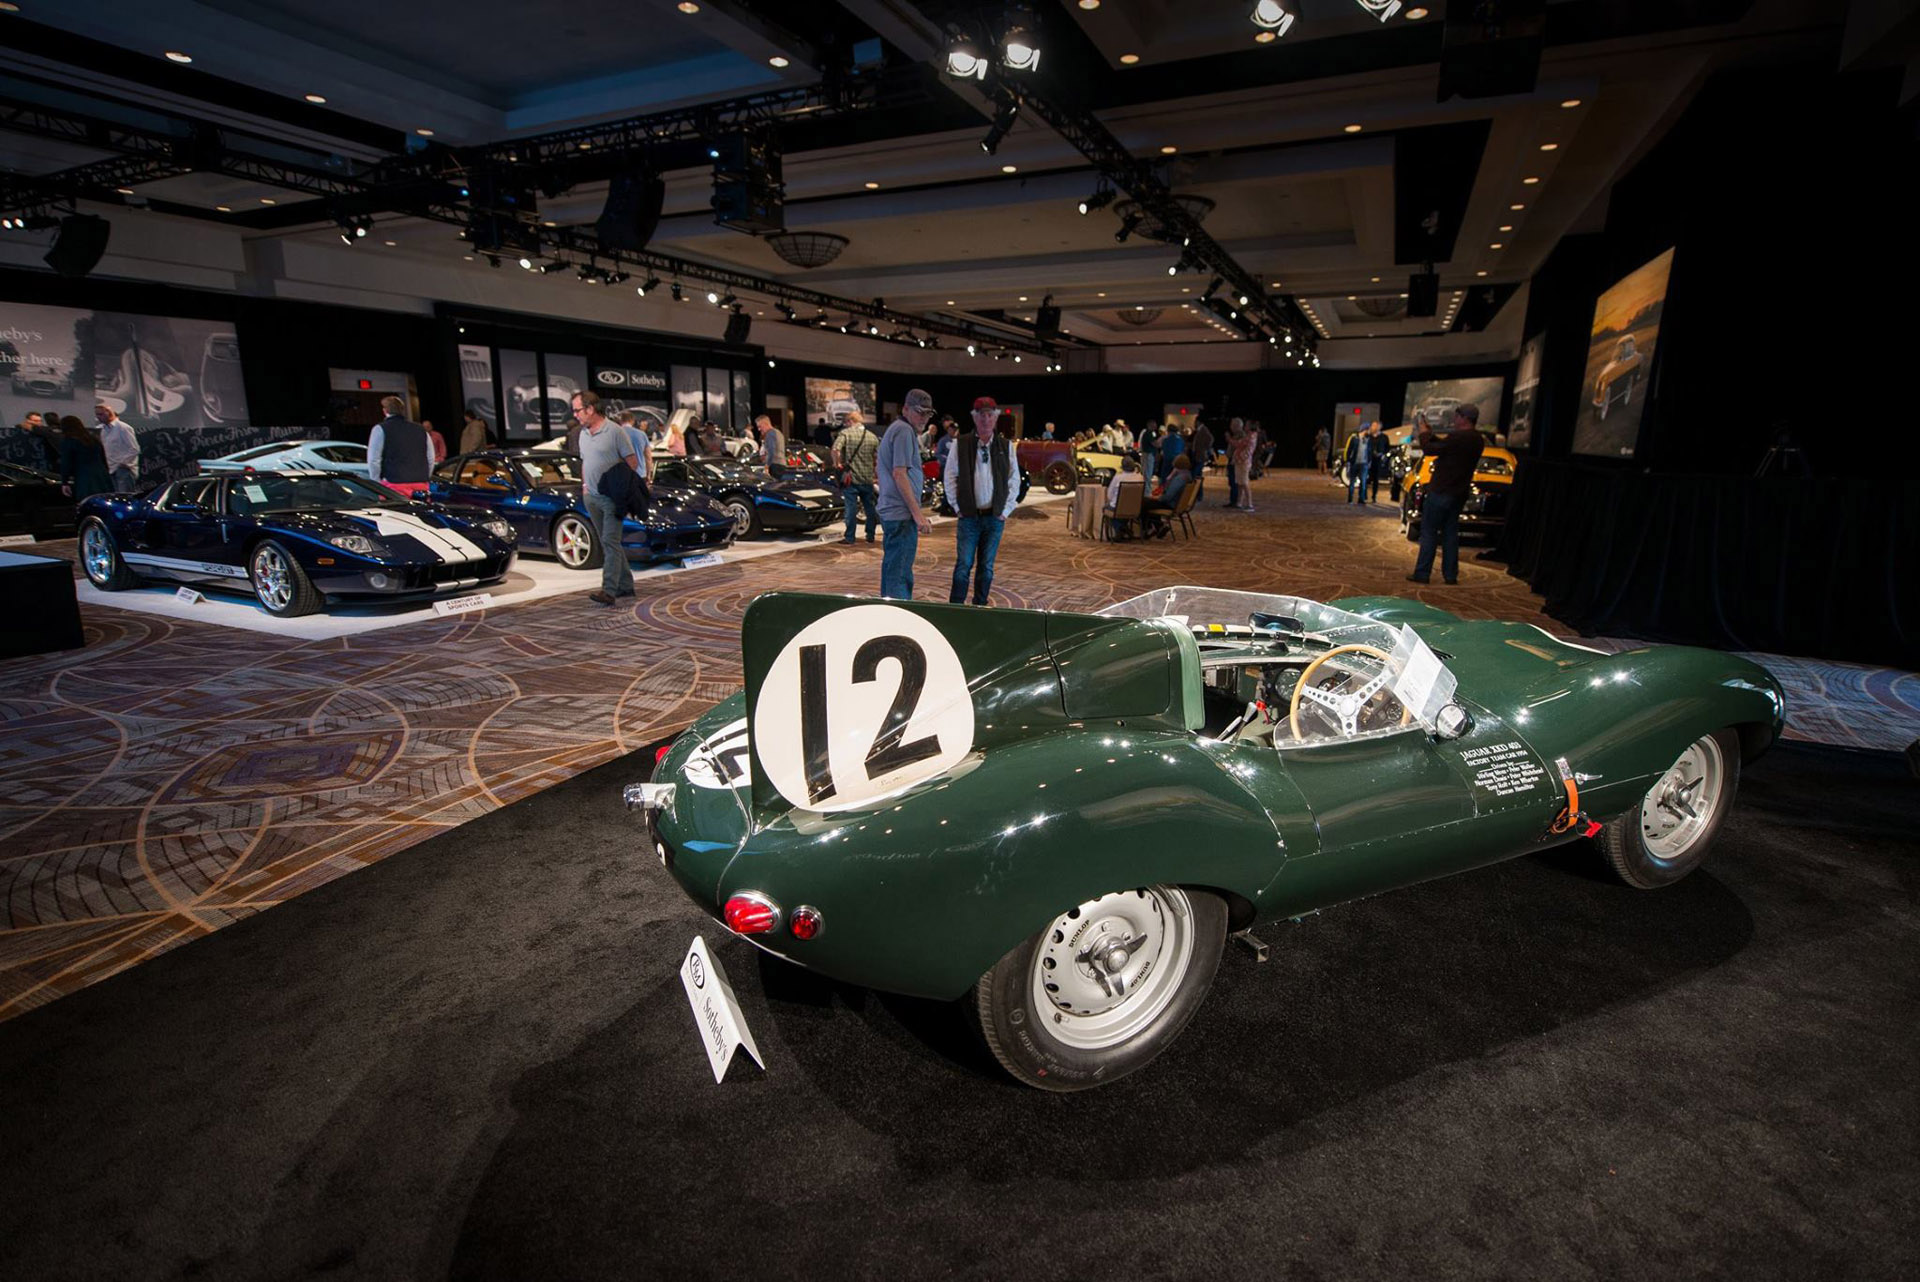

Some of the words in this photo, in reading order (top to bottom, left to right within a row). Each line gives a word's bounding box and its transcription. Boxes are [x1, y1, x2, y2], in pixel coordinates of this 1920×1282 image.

[30, 353, 66, 366] here.
[631, 374, 666, 388] Sotheby's
[799, 634, 943, 806] 12
[1460, 747, 1491, 761] JAGUAR
[1489, 743, 1509, 754] XKD
[1466, 757, 1490, 767] FACTORY
[1490, 753, 1507, 762] TEAM
[1505, 751, 1517, 759] CAR
[1069, 919, 1090, 948] DUNLOP
[1130, 960, 1151, 988] DUNLOP
[703, 996, 729, 1062] Sotheby's
